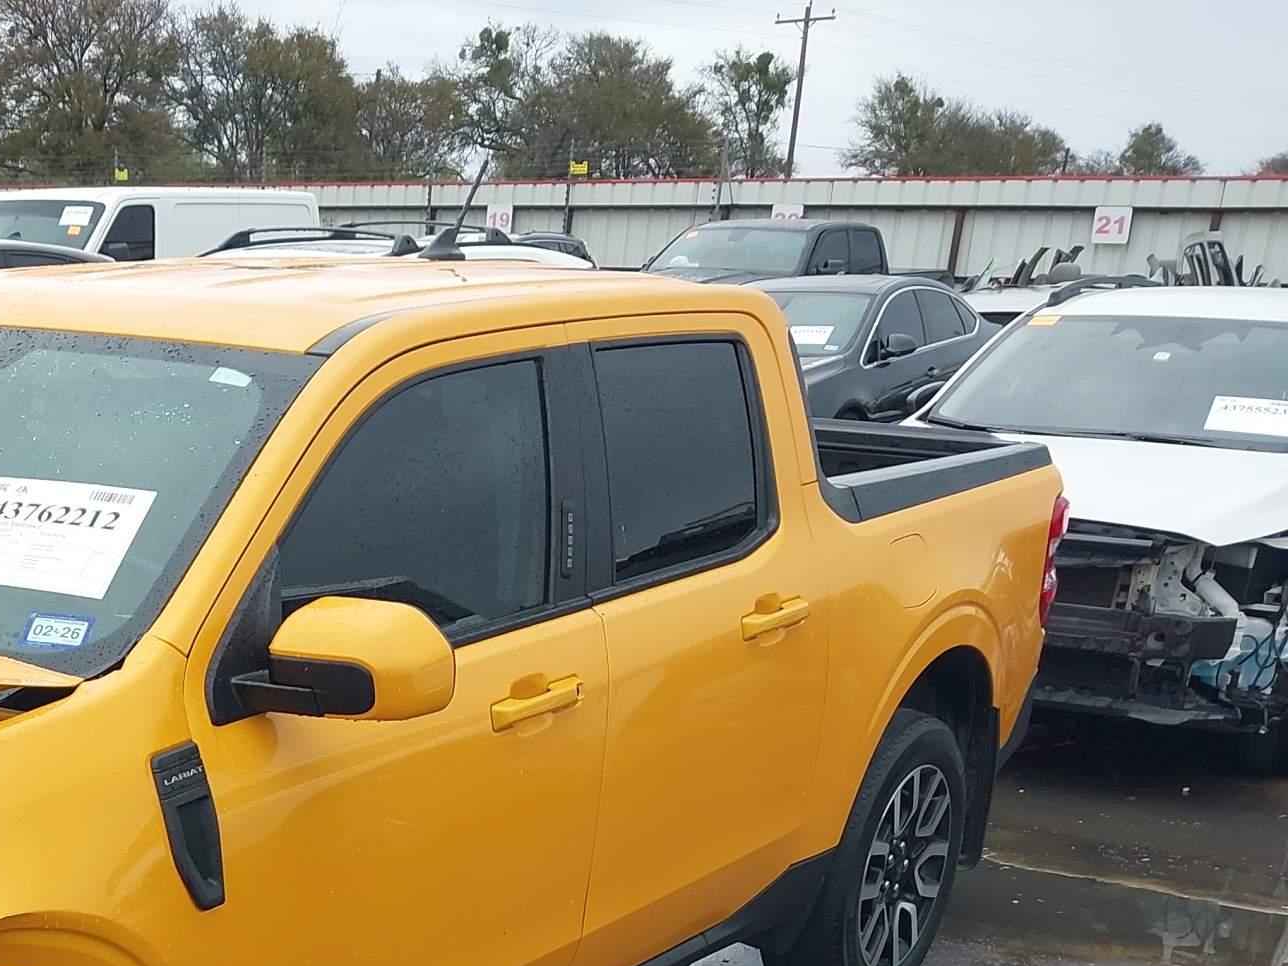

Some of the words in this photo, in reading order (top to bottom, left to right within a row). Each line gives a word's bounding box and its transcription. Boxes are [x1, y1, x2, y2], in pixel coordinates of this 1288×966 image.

[489, 212, 510, 228] 19
[1095, 216, 1125, 234] 21
[164, 765, 203, 786] LARIAT
